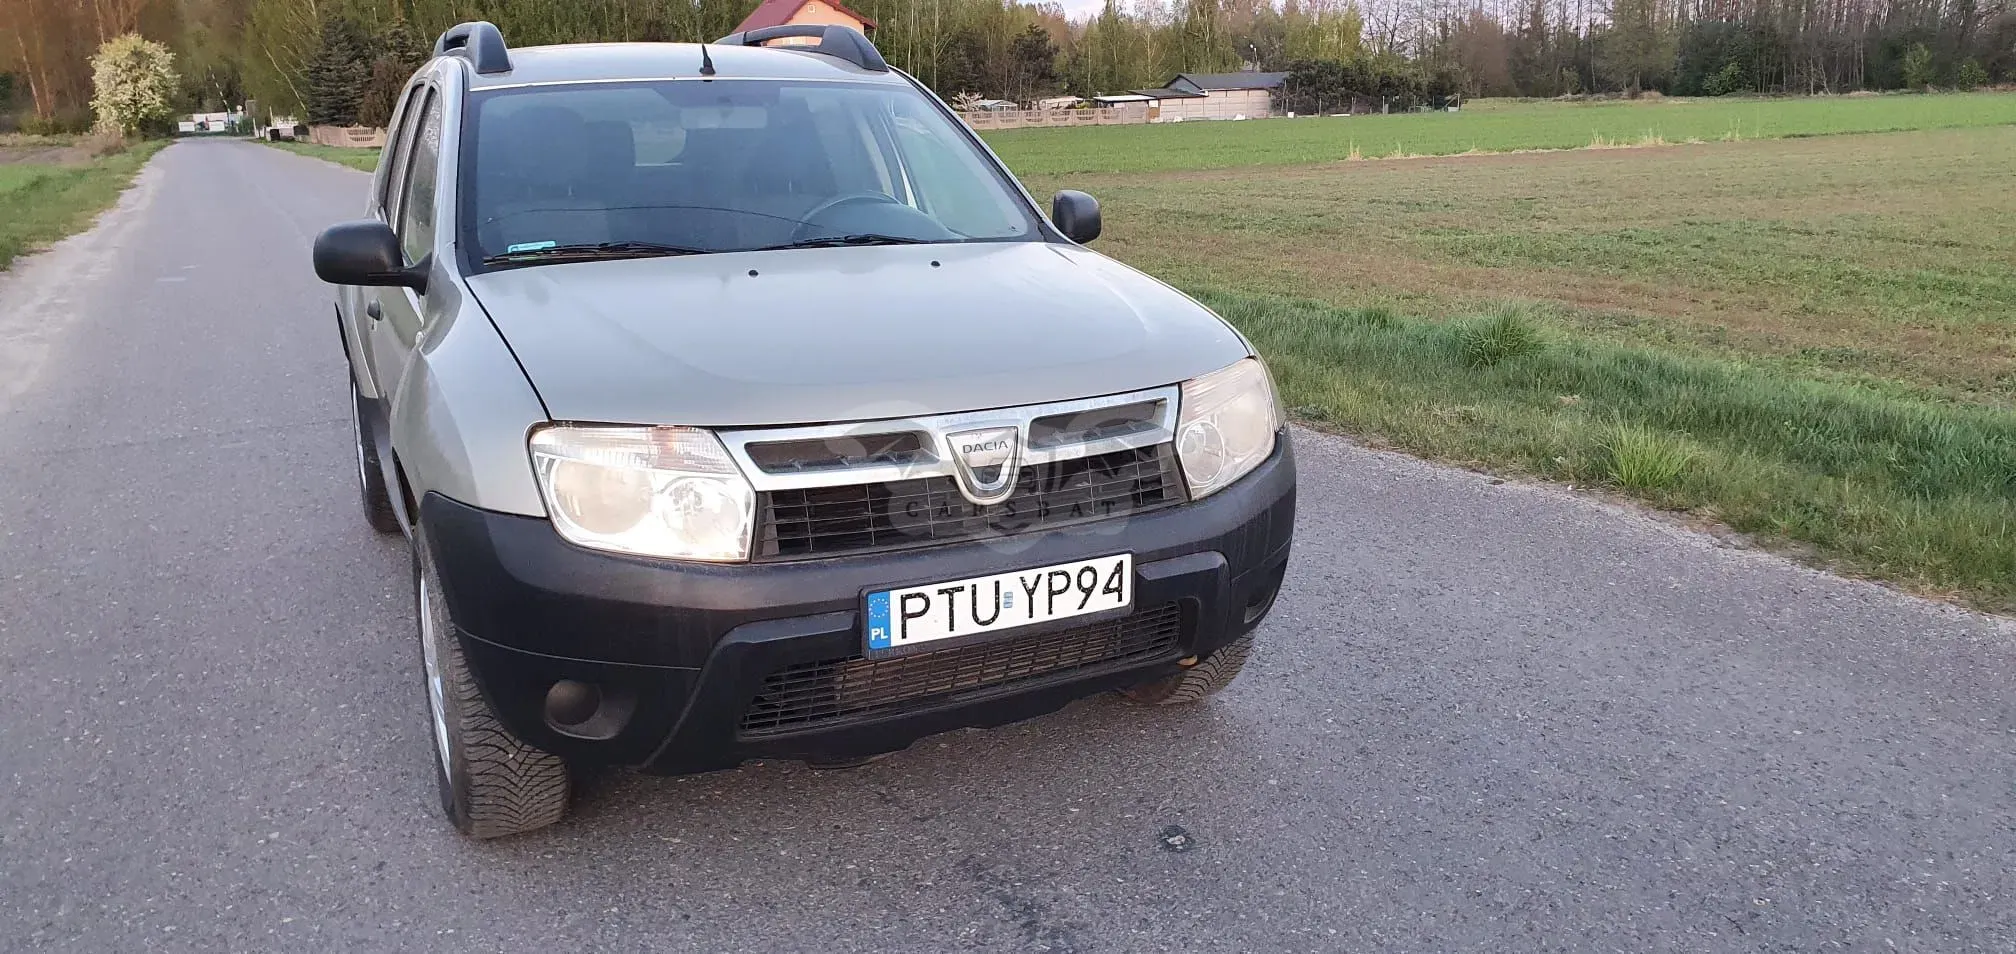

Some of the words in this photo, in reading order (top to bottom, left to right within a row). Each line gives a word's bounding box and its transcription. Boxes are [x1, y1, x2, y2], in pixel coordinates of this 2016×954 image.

[963, 440, 1008, 453] DACIA
[900, 580, 1000, 639] PTU
[1020, 560, 1124, 618] YP94
[871, 628, 888, 641] PL
